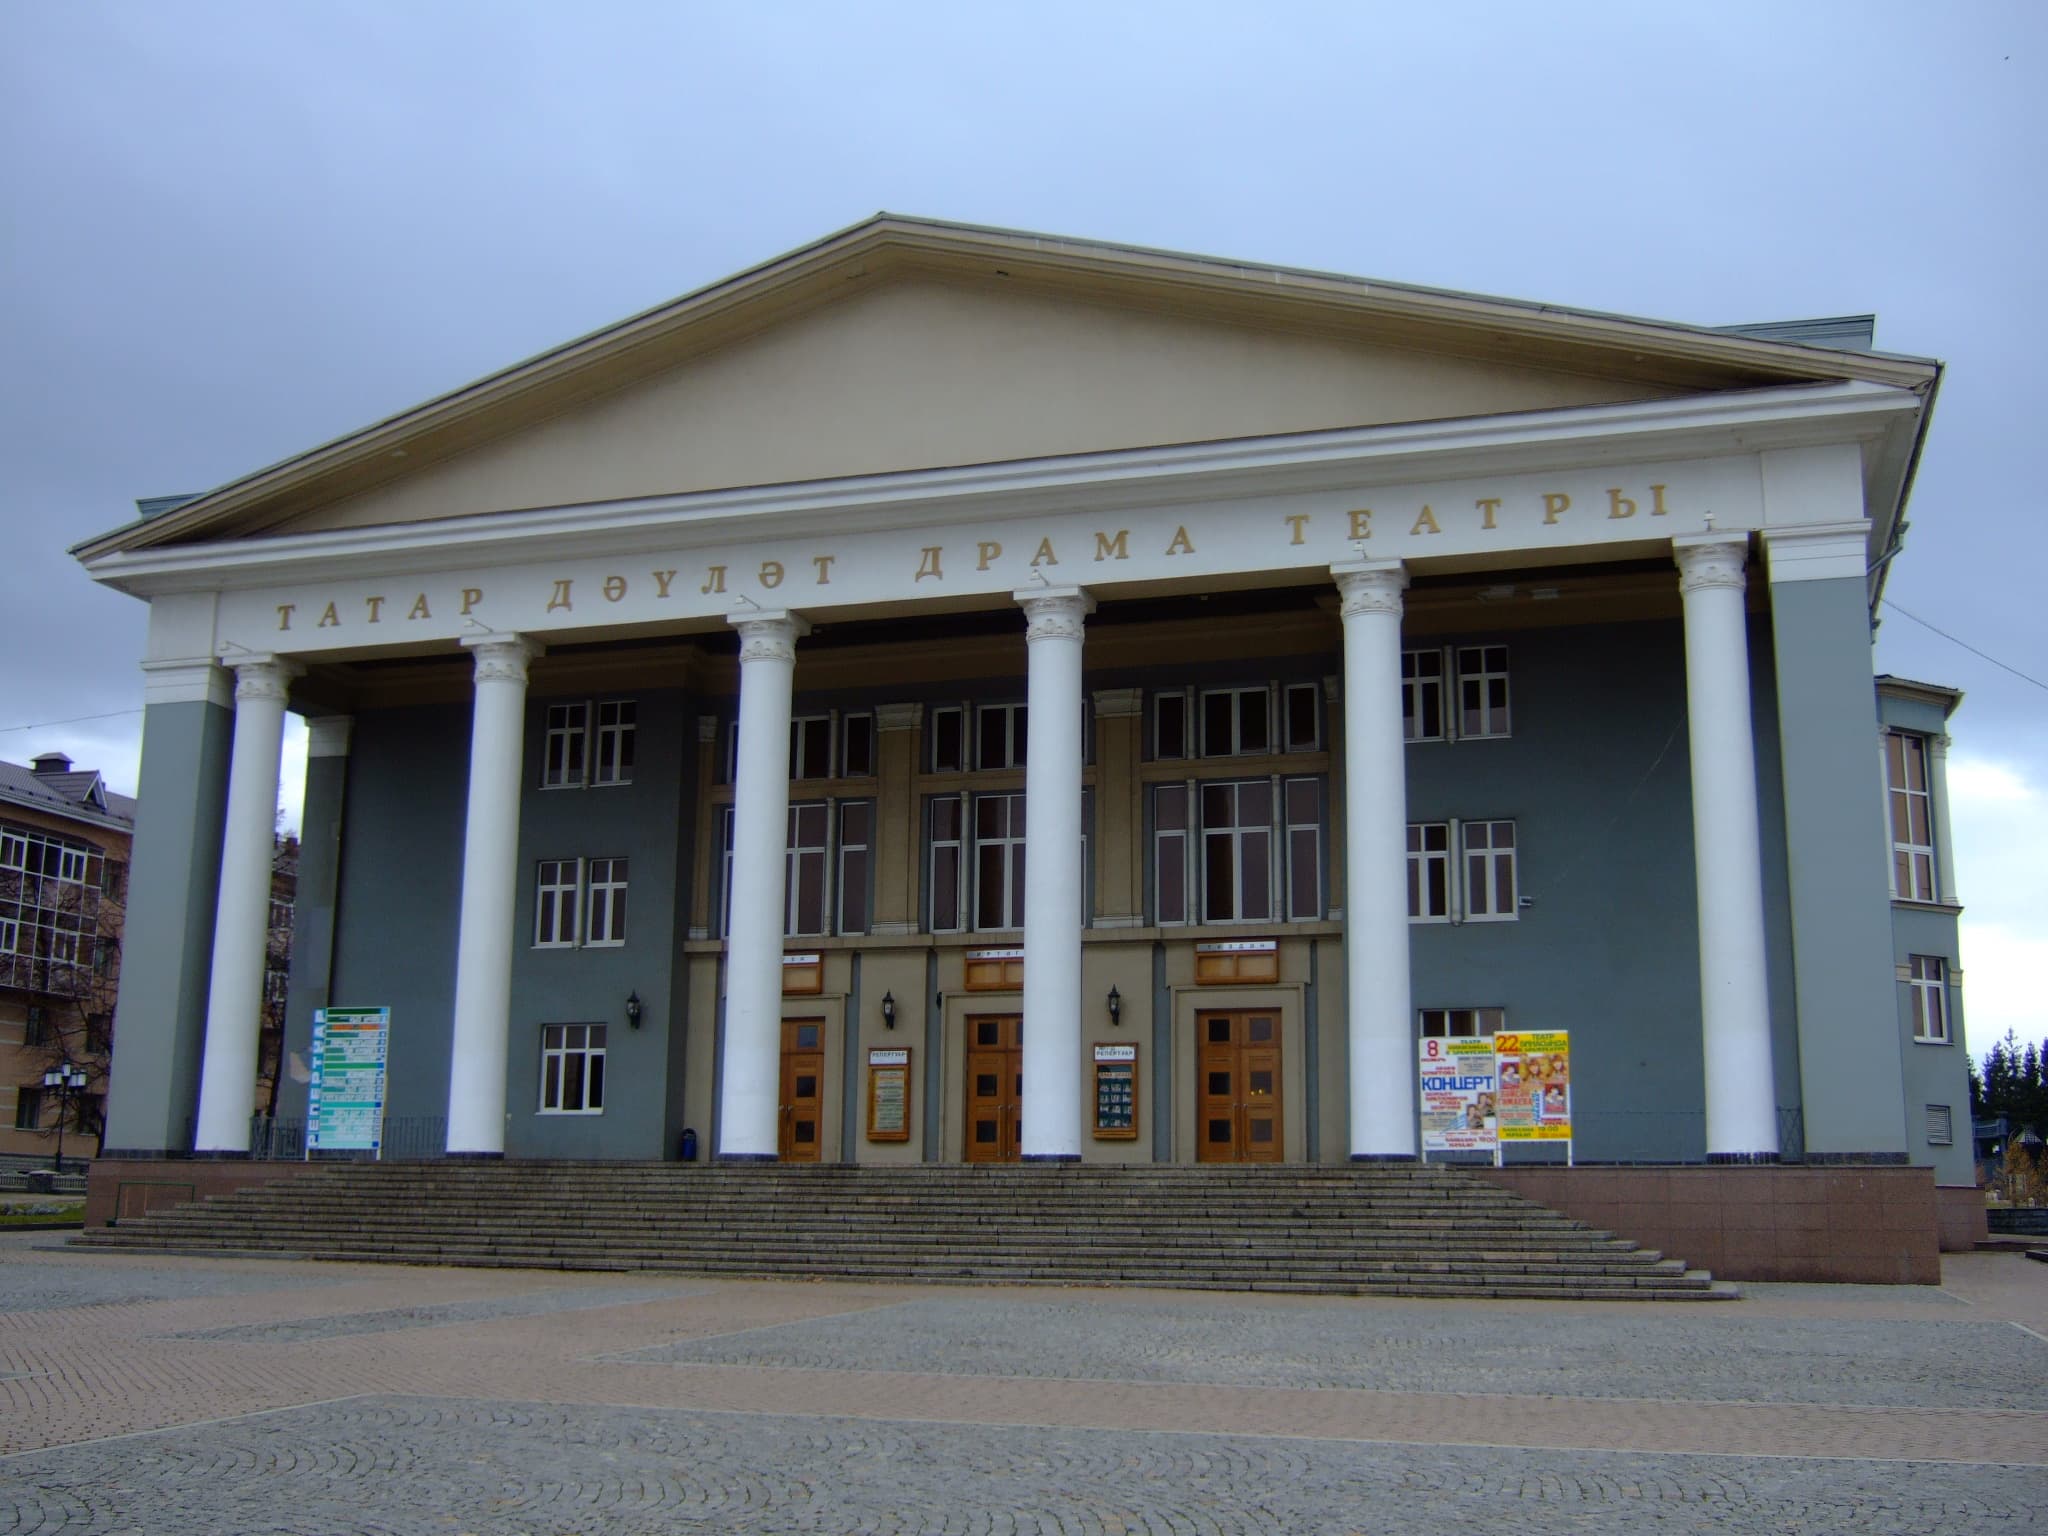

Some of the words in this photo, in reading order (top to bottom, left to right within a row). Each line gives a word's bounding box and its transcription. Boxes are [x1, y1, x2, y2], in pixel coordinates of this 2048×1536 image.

[277, 588, 483, 631] ТАТАР
[547, 555, 836, 613] ДӘҮЛӘТ
[914, 526, 1196, 582] ДРАМА
[1286, 484, 1669, 546] ТЕАТРЫ
[1427, 1040, 1438, 1057] 8
[1496, 1034, 1519, 1052] 22
[307, 1009, 326, 1147] РЕПЕРТУАР
[1422, 1076, 1493, 1091] КОНЦЕРТ
